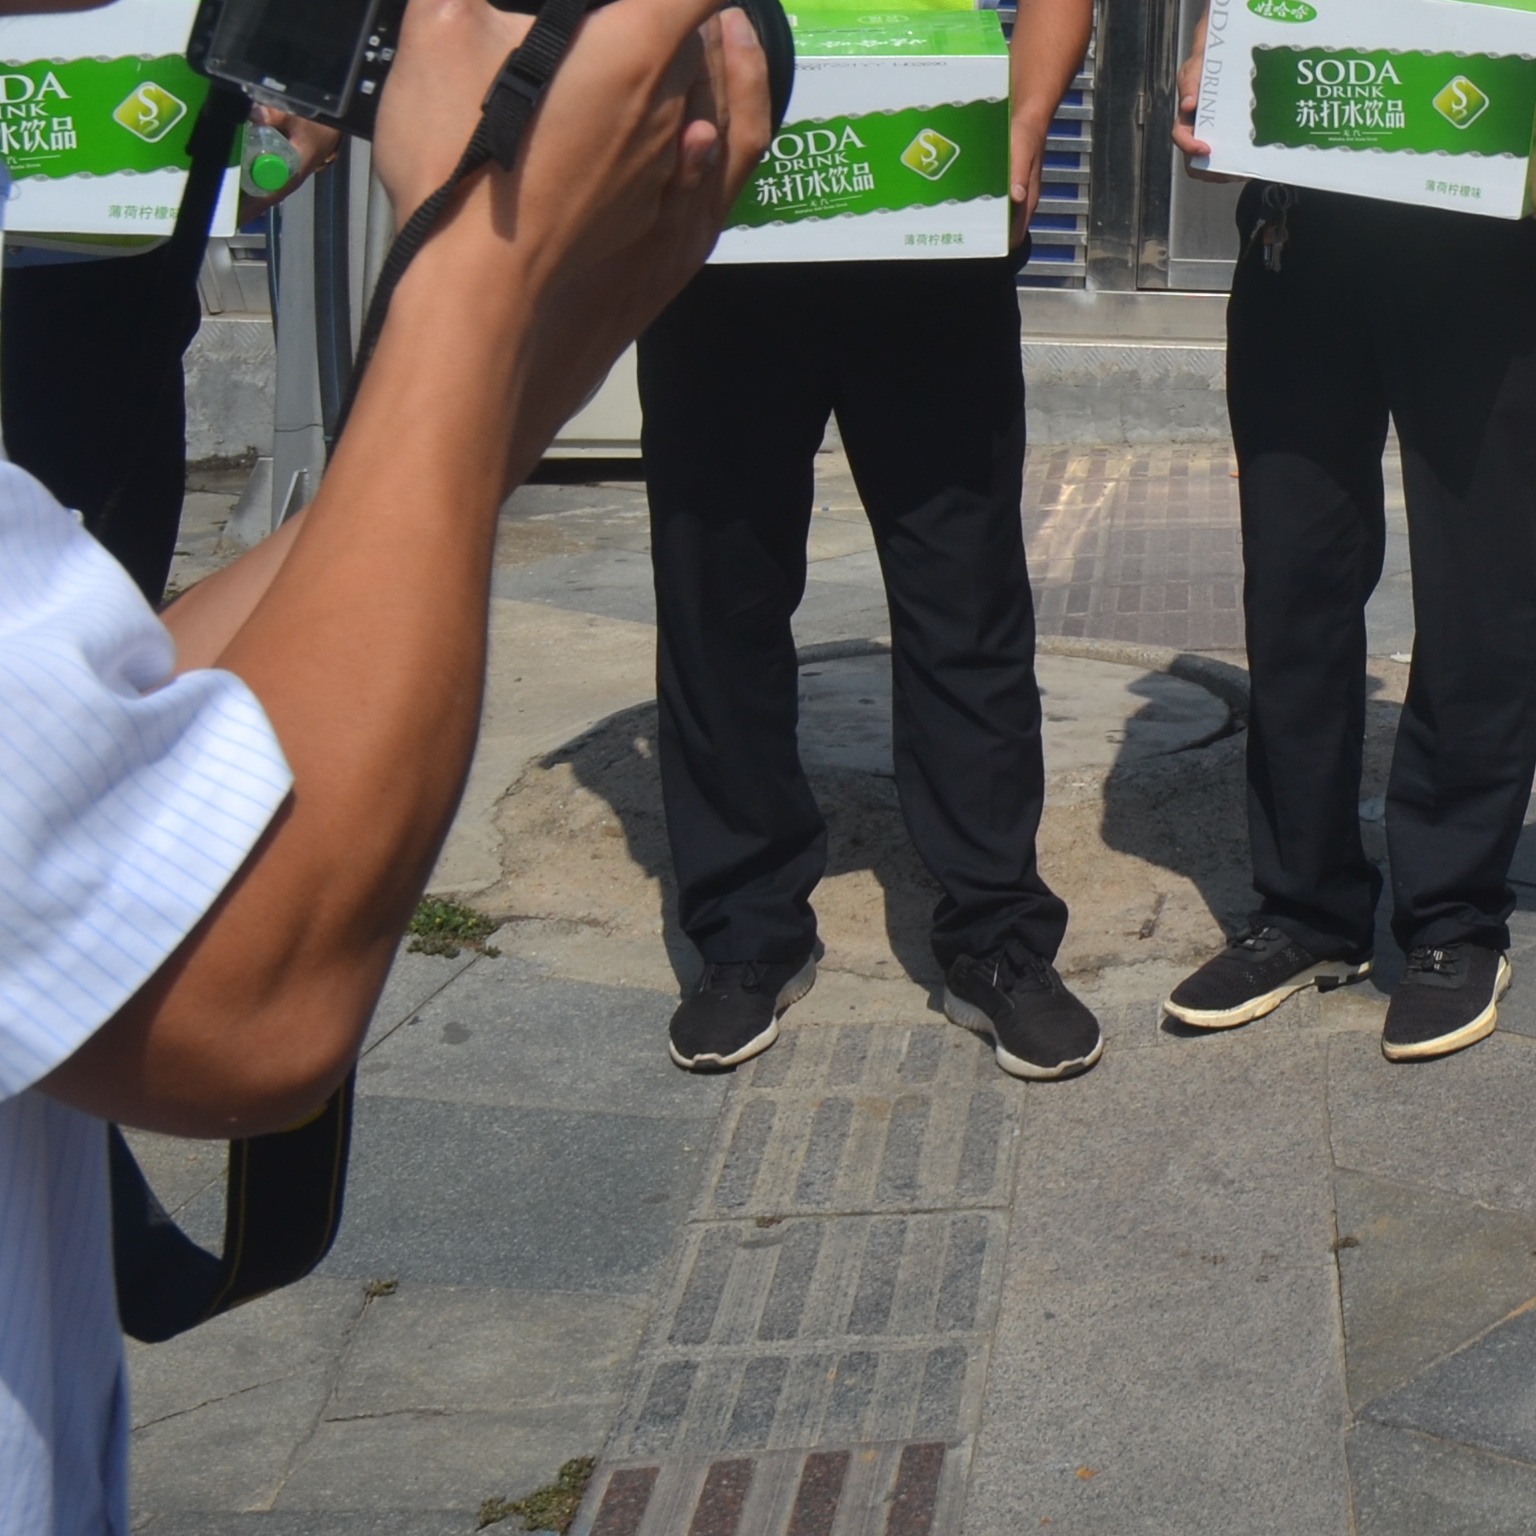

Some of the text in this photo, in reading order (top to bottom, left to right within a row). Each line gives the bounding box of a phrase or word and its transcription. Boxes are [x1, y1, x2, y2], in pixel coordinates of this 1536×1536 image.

[1297, 59, 1403, 86] SODA
[1199, 58, 1222, 129] DRINK
[1316, 85, 1385, 99] DRINK
[1295, 99, 1406, 130] 苏打水饮品
[774, 152, 850, 174] DRINK
[755, 161, 875, 206] 苏打水饮品
